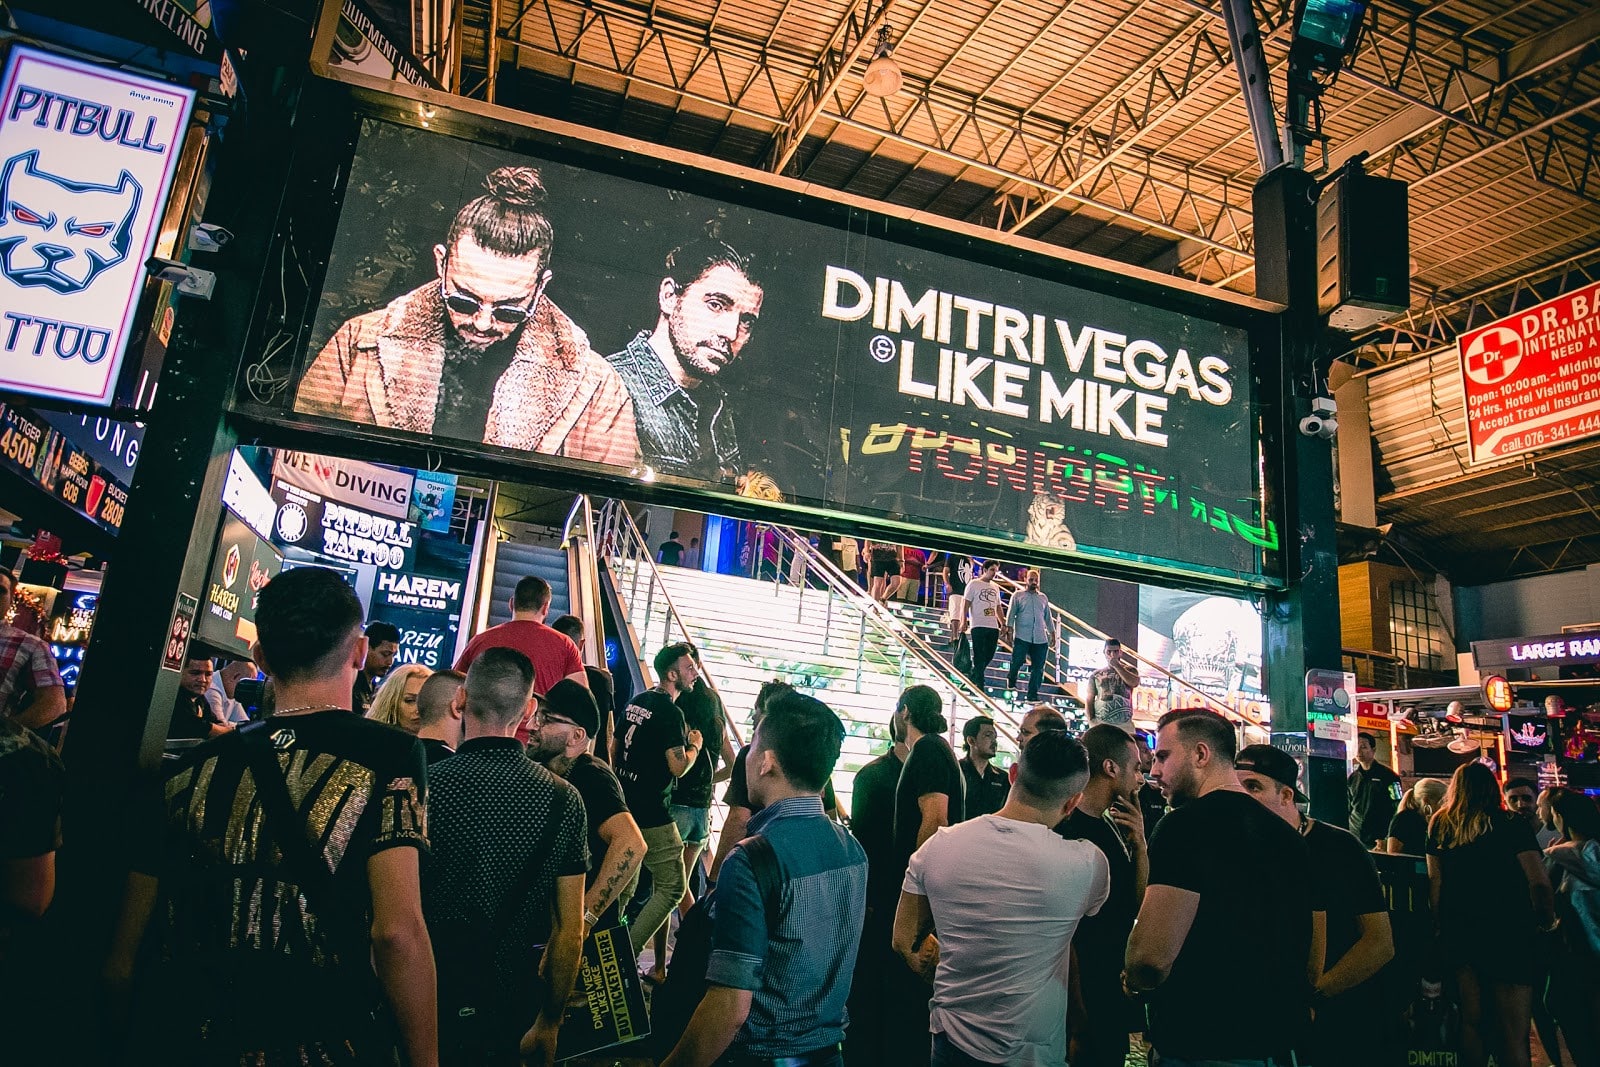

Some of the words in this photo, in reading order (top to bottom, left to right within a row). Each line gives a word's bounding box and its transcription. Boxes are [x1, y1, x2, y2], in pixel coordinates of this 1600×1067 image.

[136, 0, 207, 54] KELING
[8, 85, 166, 154] PITBULL
[5, 311, 113, 364] TTOO
[820, 265, 1046, 365] DIMITRI
[1055, 319, 1232, 406] VEGAS
[1521, 306, 1568, 339] DR.
[1525, 315, 1600, 356] INTERNATI
[1483, 350, 1503, 364] Dr.
[1551, 342, 1583, 361] NEED
[1589, 336, 1598, 348] A
[898, 338, 1029, 420] LIKE
[1040, 371, 1168, 447] MIKE
[1470, 390, 1498, 406] Open:
[1559, 356, 1600, 378] Midnig
[1469, 408, 1481, 421] 24
[1483, 404, 1503, 416] Hrs.
[1505, 391, 1533, 409] Hotel
[1535, 379, 1579, 399] Visiting
[1479, 412, 1514, 432] Accept
[1516, 401, 1550, 420] Travel
[1554, 388, 1600, 409] Insuran
[7, 409, 15, 422] 5
[20, 416, 41, 443] TIGER
[60, 464, 77, 481] HAPPY
[75, 474, 89, 490] HOUR
[283, 449, 311, 473] WE
[335, 470, 407, 504] DIVING
[427, 483, 445, 492] Open
[900, 427, 1165, 515] TONIGHT
[107, 482, 129, 505] BUCKET
[321, 501, 413, 548] PITBULL
[323, 528, 404, 569] TATTOO
[210, 583, 240, 613] HAREM
[378, 572, 461, 600] HAREM
[420, 597, 446, 610] CLUB
[399, 629, 443, 649] REM
[1510, 642, 1566, 661] LARGE
[394, 647, 438, 666] AN'S
[598, 933, 613, 963] HERE
[582, 956, 594, 992] VEGAS
[591, 964, 603, 989] MIKE
[605, 964, 626, 1010] TICKETS
[586, 991, 604, 1030] DIMITRI
[597, 989, 610, 1014] LIKE
[616, 1011, 631, 1035] BUY
[1408, 1051, 1458, 1066] DIMITRI
